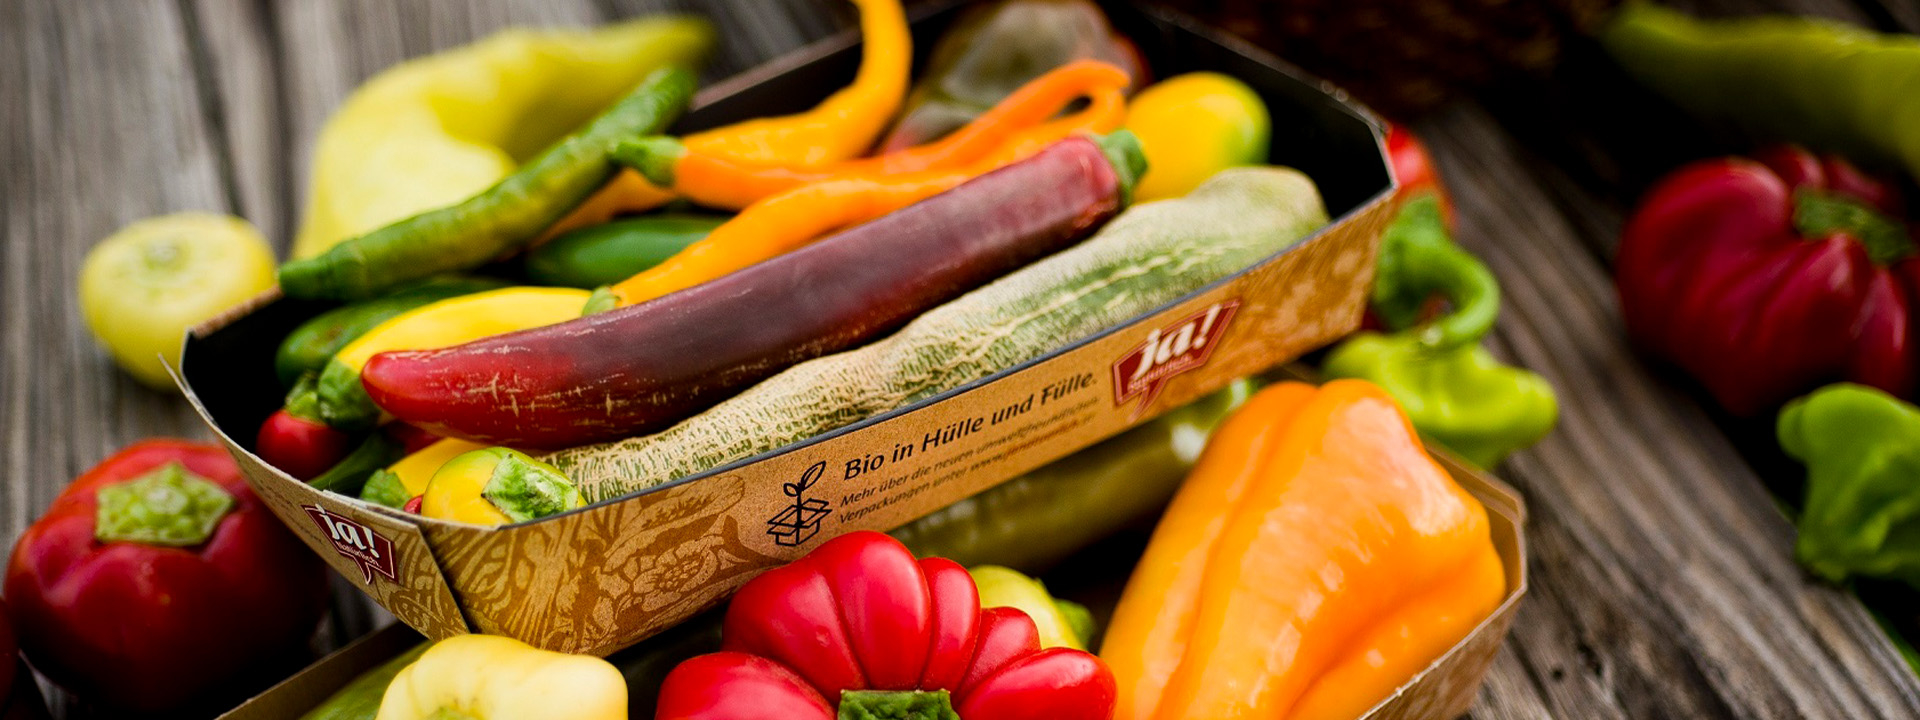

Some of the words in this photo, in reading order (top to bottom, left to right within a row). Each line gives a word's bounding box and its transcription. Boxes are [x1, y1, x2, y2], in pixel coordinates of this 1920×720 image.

[1131, 303, 1222, 381] ja!
[844, 454, 884, 481] Bio
[892, 443, 914, 463] in
[921, 418, 984, 452] Hülle
[991, 393, 1034, 425] und
[1041, 372, 1097, 405] Fülle.
[840, 486, 877, 507] Mehr
[879, 475, 908, 493] über
[911, 465, 932, 480] die
[934, 449, 973, 472] neuen
[840, 482, 930, 524] Verpackungen
[315, 503, 379, 558] ja!
